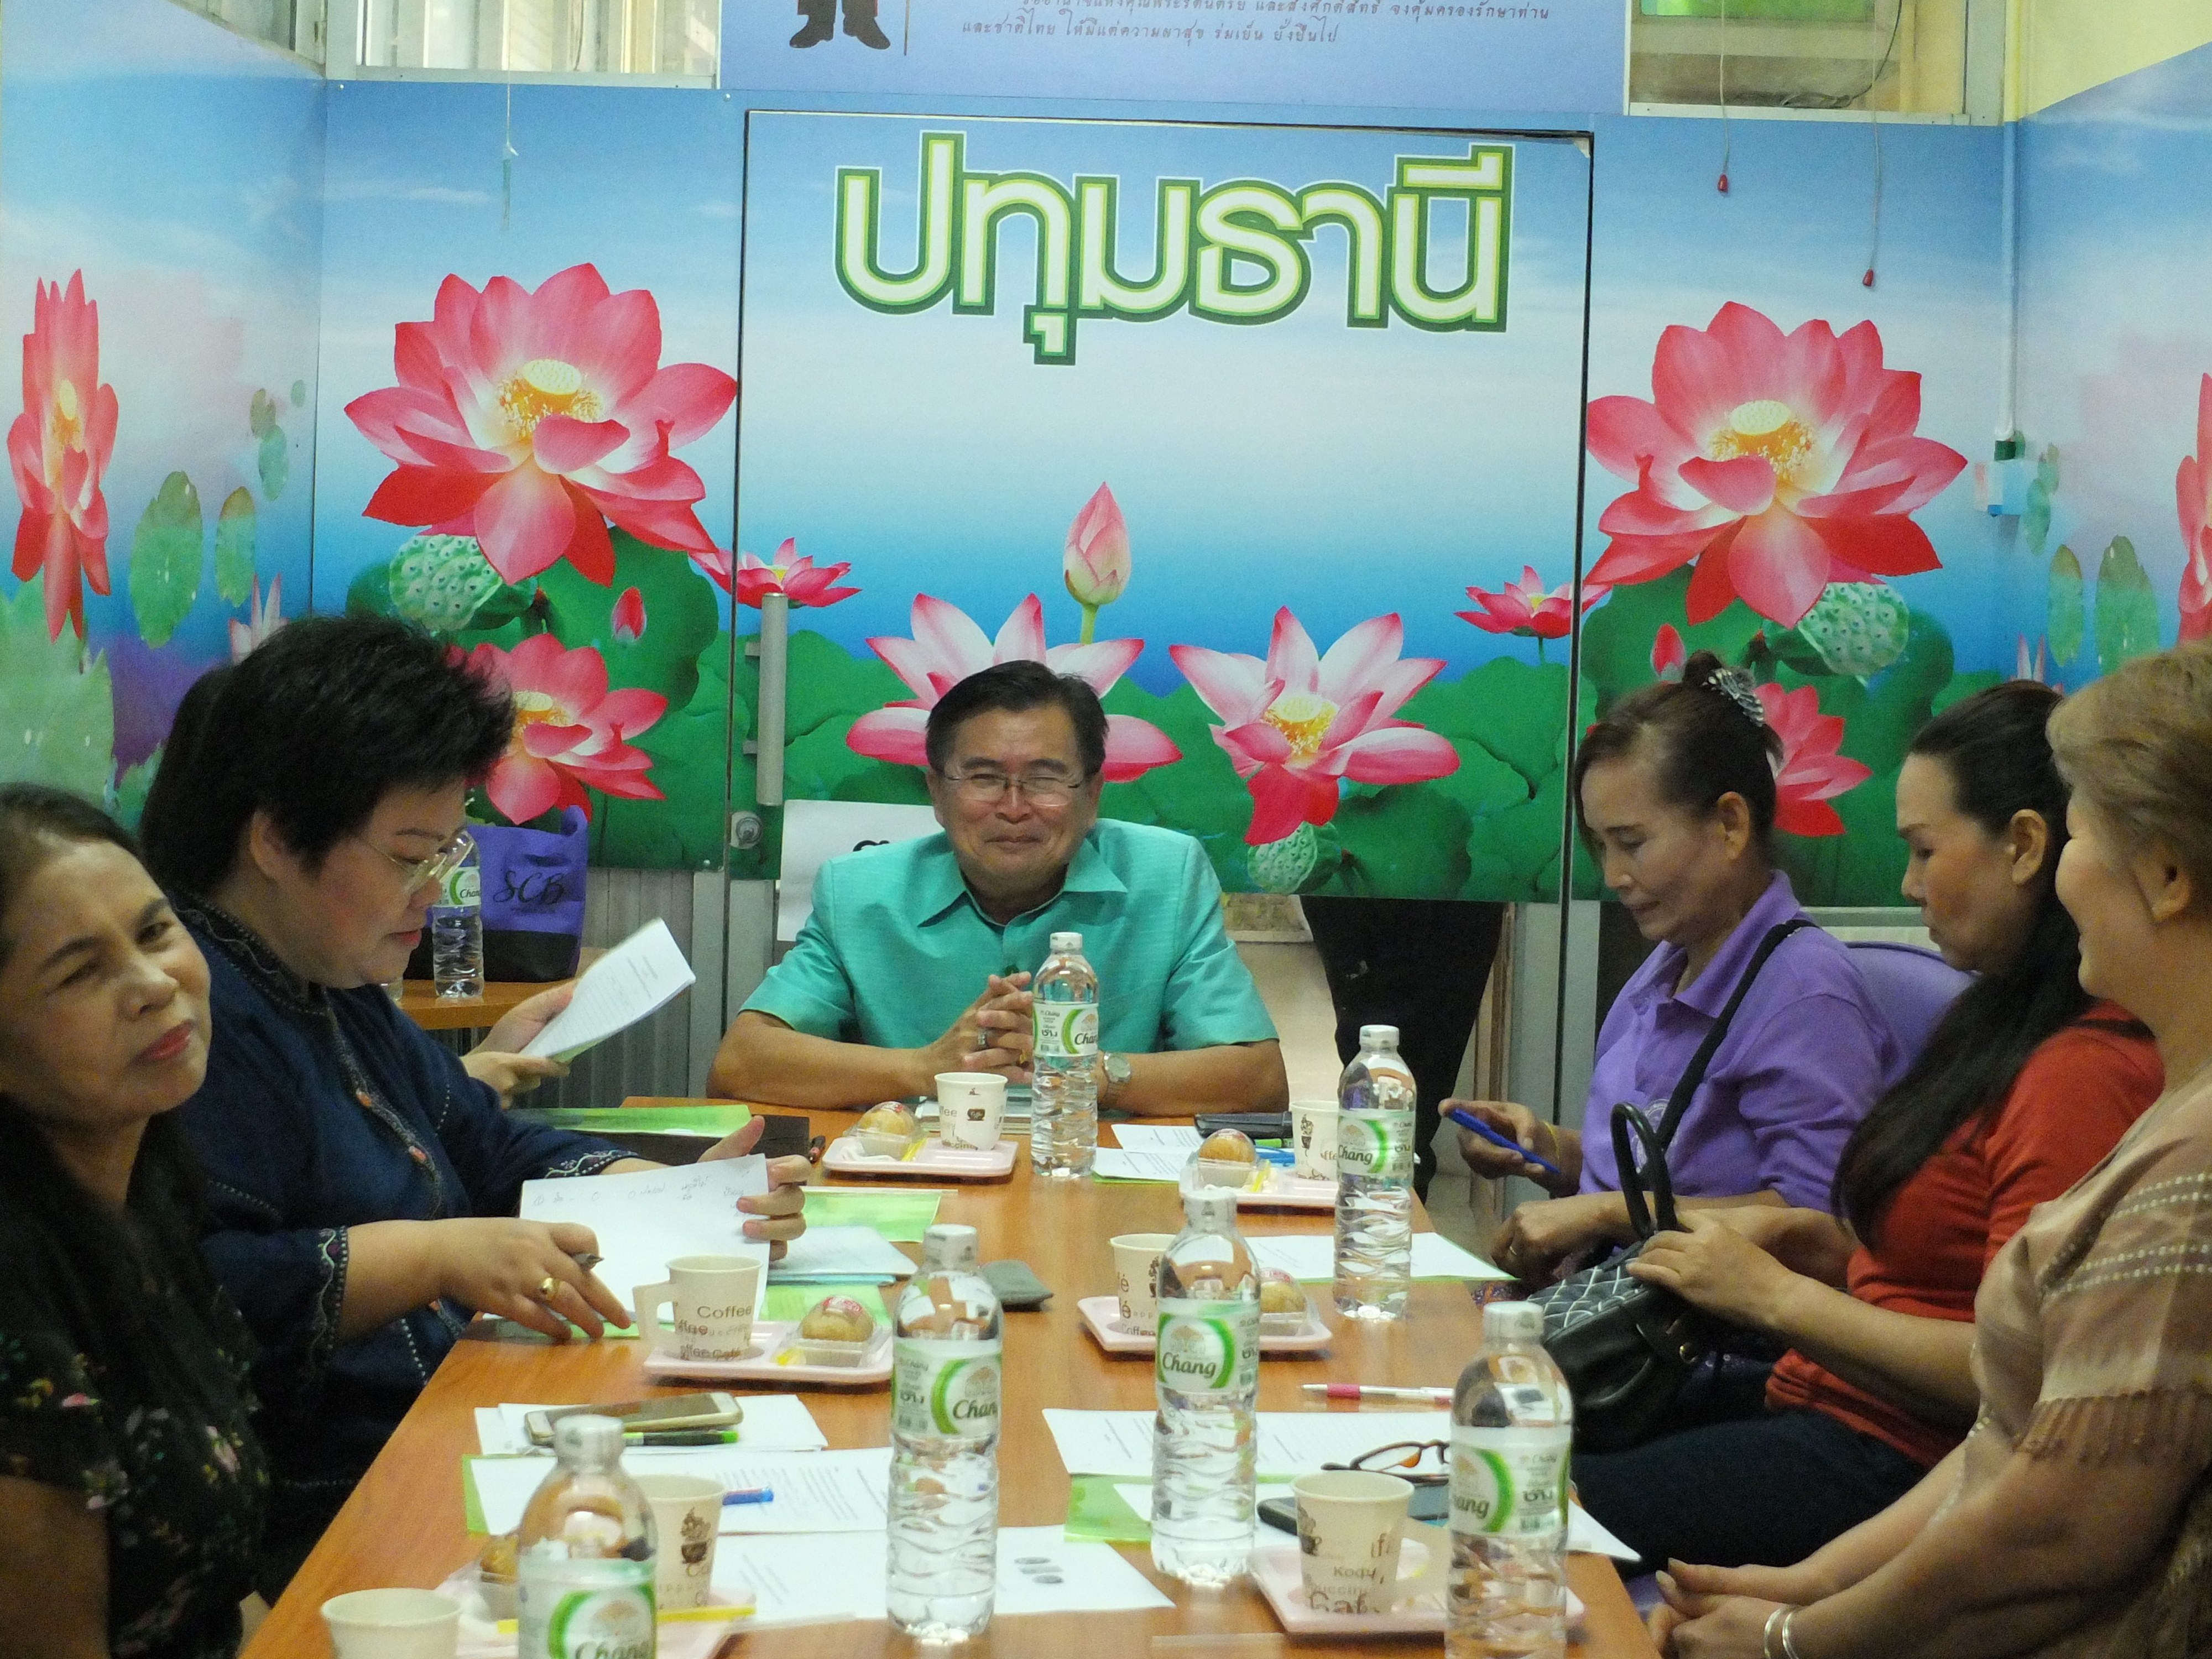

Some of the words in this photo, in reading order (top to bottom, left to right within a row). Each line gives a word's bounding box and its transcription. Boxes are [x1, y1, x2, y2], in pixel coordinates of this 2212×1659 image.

[836, 131, 1514, 364] ปทุมธานี
[493, 870, 565, 905] SCB
[1338, 1144, 1373, 1165] Chang
[697, 1306, 752, 1318] Coffee
[1162, 1351, 1216, 1379] Chang
[953, 1399, 998, 1420] Chan
[1453, 1495, 1490, 1520] ang
